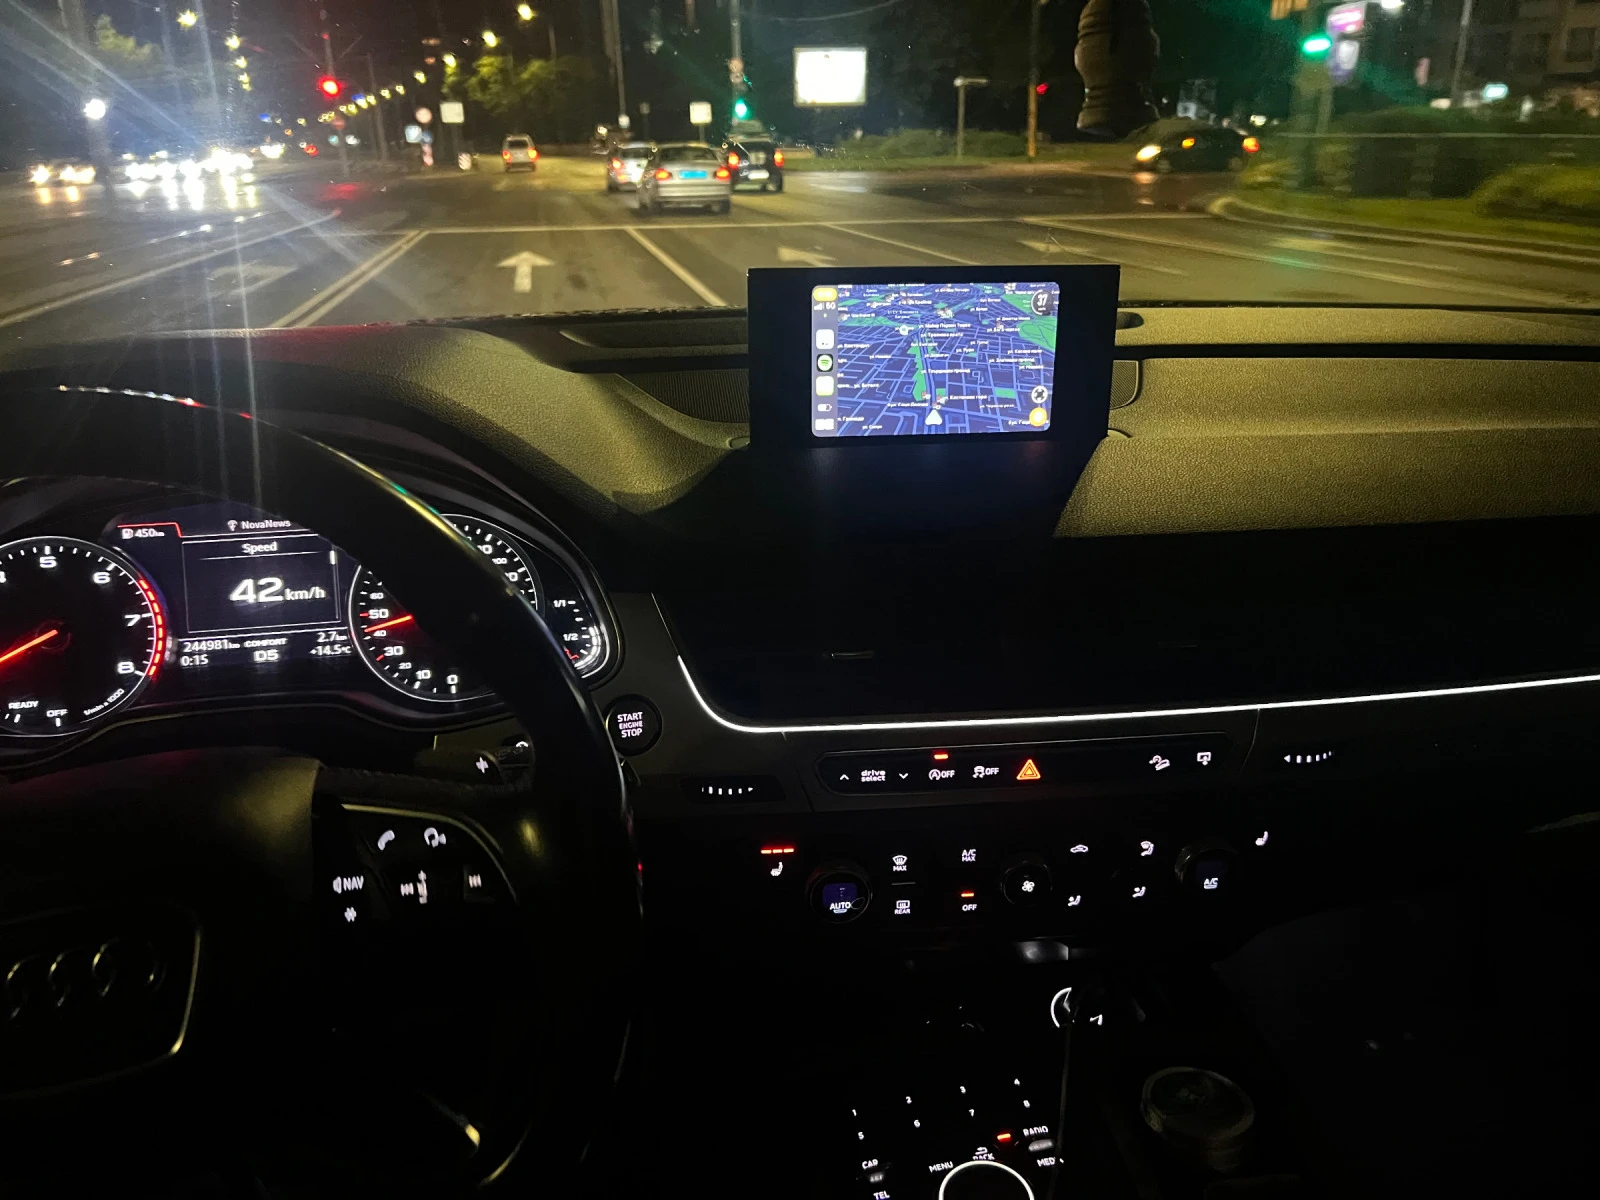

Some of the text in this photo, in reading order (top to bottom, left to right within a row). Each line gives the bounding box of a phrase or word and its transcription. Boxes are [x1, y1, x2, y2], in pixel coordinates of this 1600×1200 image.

[241, 520, 291, 530] NovaNews
[242, 541, 278, 554] Speed
[39, 556, 57, 568] 5
[93, 571, 111, 584] 6
[229, 577, 326, 604] 42 km/h
[368, 608, 389, 619] 50
[124, 614, 141, 626] 7
[563, 633, 579, 641] 1/2
[244, 638, 288, 648] COMFORT
[383, 646, 404, 656] 30
[180, 654, 209, 667] 0:15
[253, 650, 279, 662] D5
[117, 661, 135, 674] 8
[416, 669, 432, 680] 10
[446, 674, 458, 685] 0
[106, 688, 125, 703] 1000
[8, 701, 39, 709] READY
[46, 709, 68, 718] OFF
[617, 712, 643, 722] START
[619, 721, 643, 730] ENGINE
[621, 728, 642, 738] STOP
[941, 770, 955, 778] OFF
[985, 767, 1000, 775] OFF
[962, 849, 976, 857] A/C
[343, 876, 364, 891] NAV
[830, 902, 851, 910] AUTO
[1022, 1125, 1049, 1137] RADIO
[862, 1159, 878, 1170] CAR
[929, 1161, 954, 1173] MENU
[873, 1190, 890, 1200] TEL
